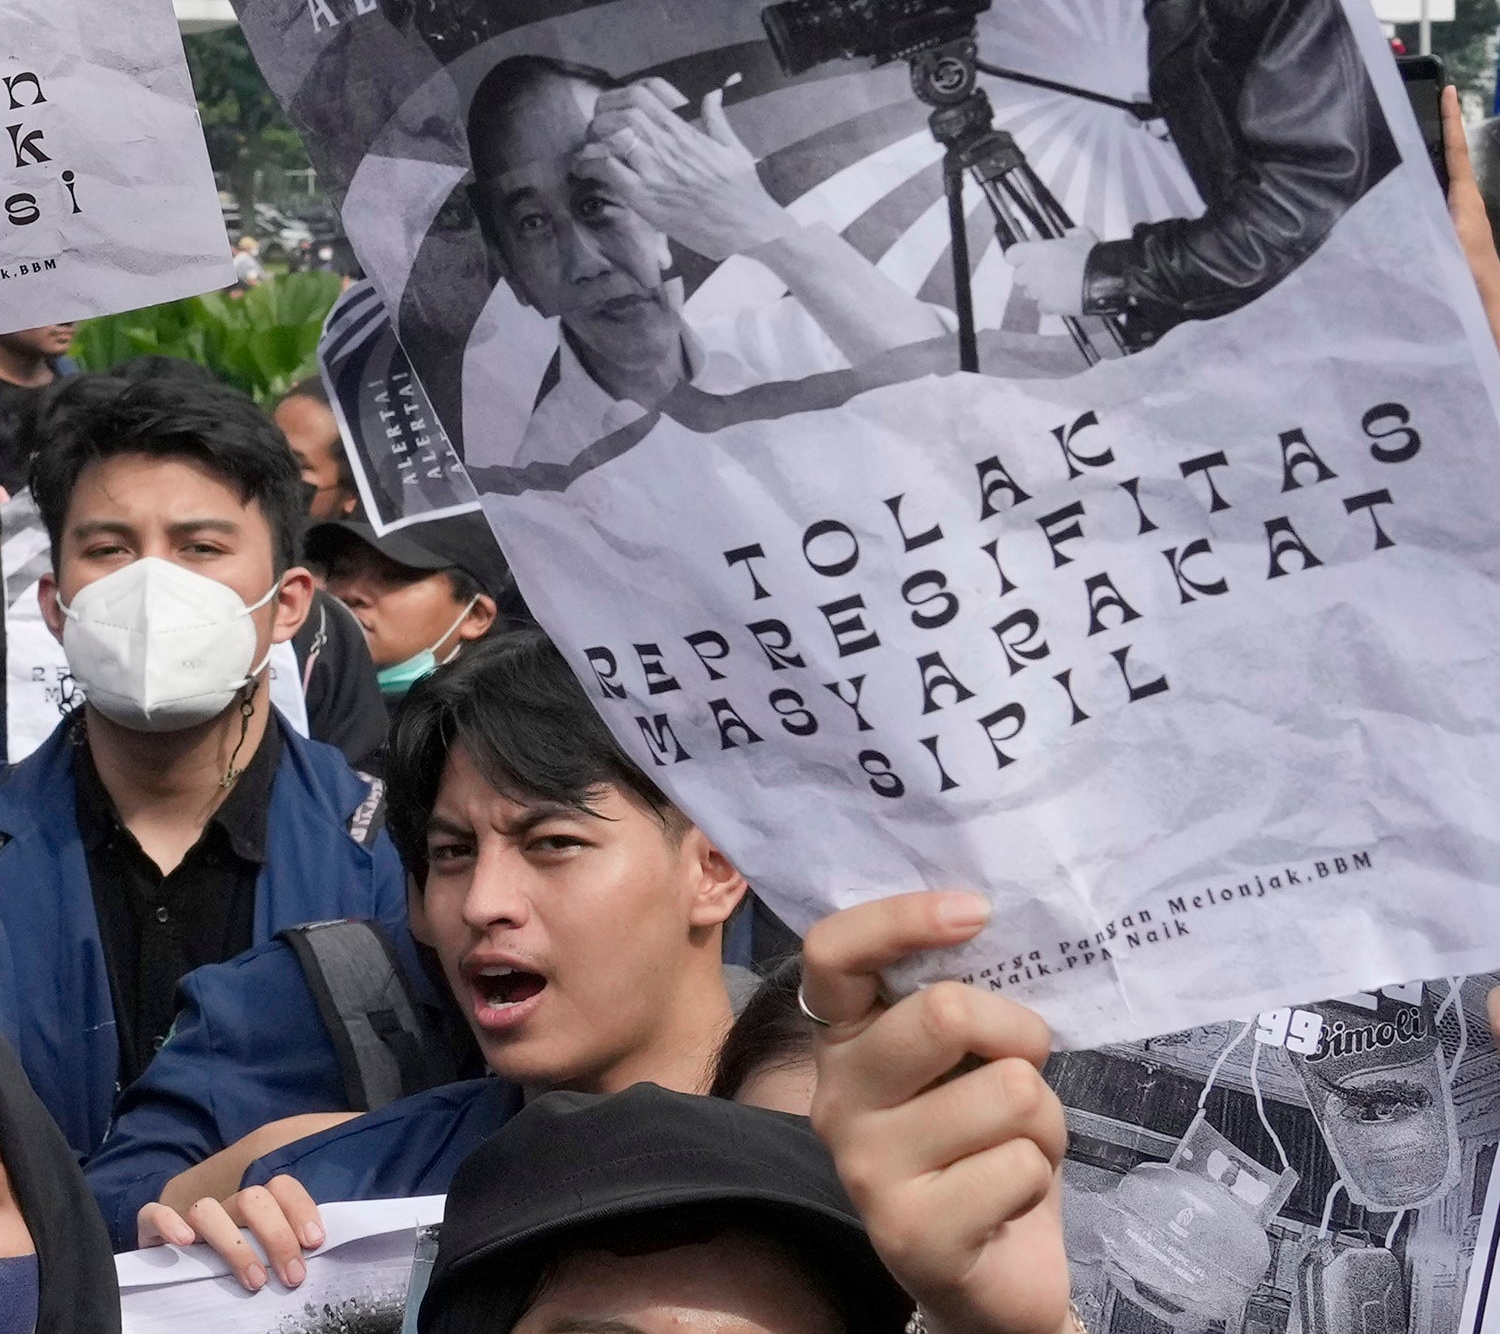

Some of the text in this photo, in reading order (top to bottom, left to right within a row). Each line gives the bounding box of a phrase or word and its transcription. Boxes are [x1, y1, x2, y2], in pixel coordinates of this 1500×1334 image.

[366, 379, 419, 484] ALERTA!
[391, 371, 442, 478] ALERTA!
[584, 401, 1423, 700] REPRESIFITAS
[723, 409, 1116, 602] TOLAK
[635, 489, 1399, 768] MASYARAKAT
[856, 645, 1170, 800] SIPIL
[1058, 910, 1153, 956] Pangan
[1168, 851, 1374, 916] Melonjak.BBM
[1127, 919, 1192, 948] Naik
